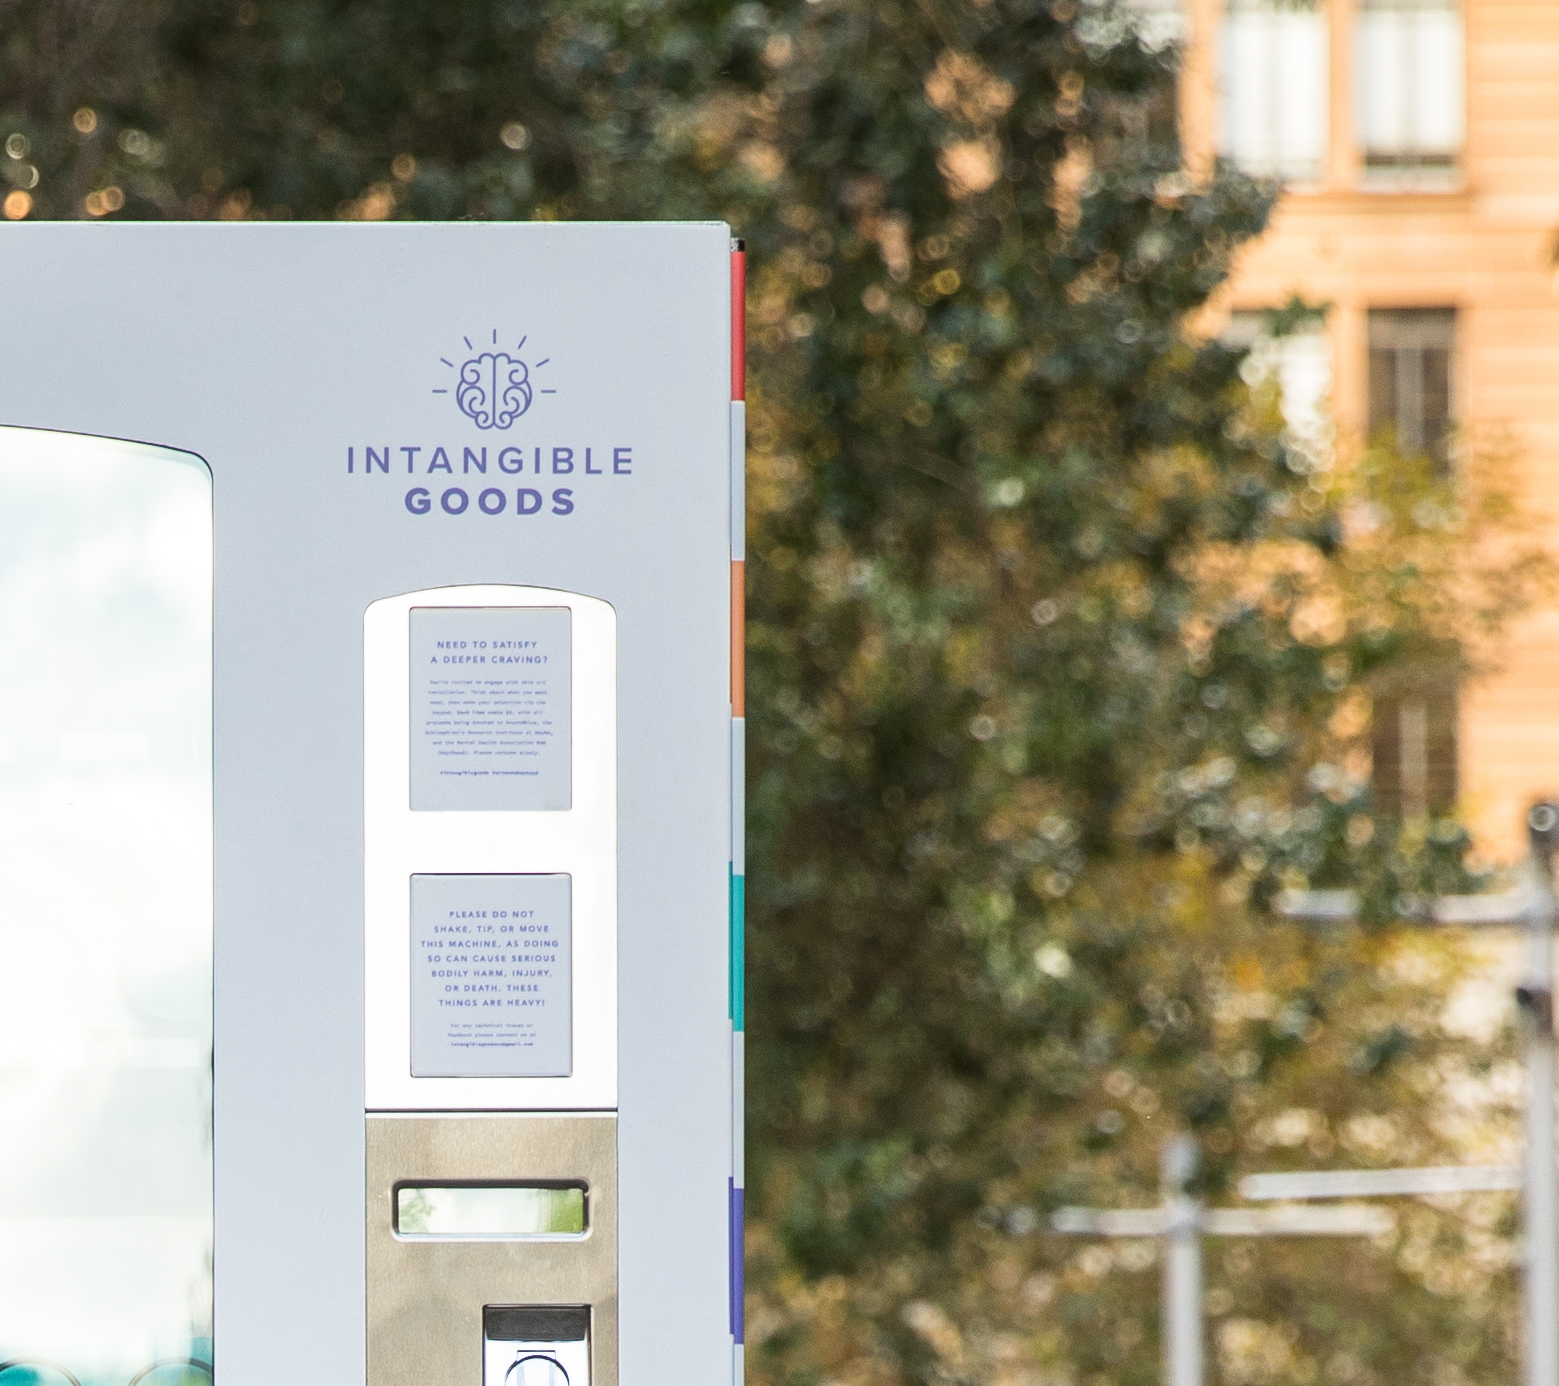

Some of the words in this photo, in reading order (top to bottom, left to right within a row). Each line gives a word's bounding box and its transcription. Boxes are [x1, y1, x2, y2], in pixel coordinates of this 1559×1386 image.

[347, 446, 632, 474] INTANGIBLE
[404, 487, 574, 515] GOODS
[434, 925, 471, 933] SHAKE,
[477, 925, 494, 933] TIP,
[499, 925, 514, 933] OR
[519, 925, 548, 933] MOVE
[421, 940, 443, 948] THIS
[448, 940, 500, 948] MACHINE,
[506, 940, 518, 948] AS
[523, 940, 558, 948] DOING
